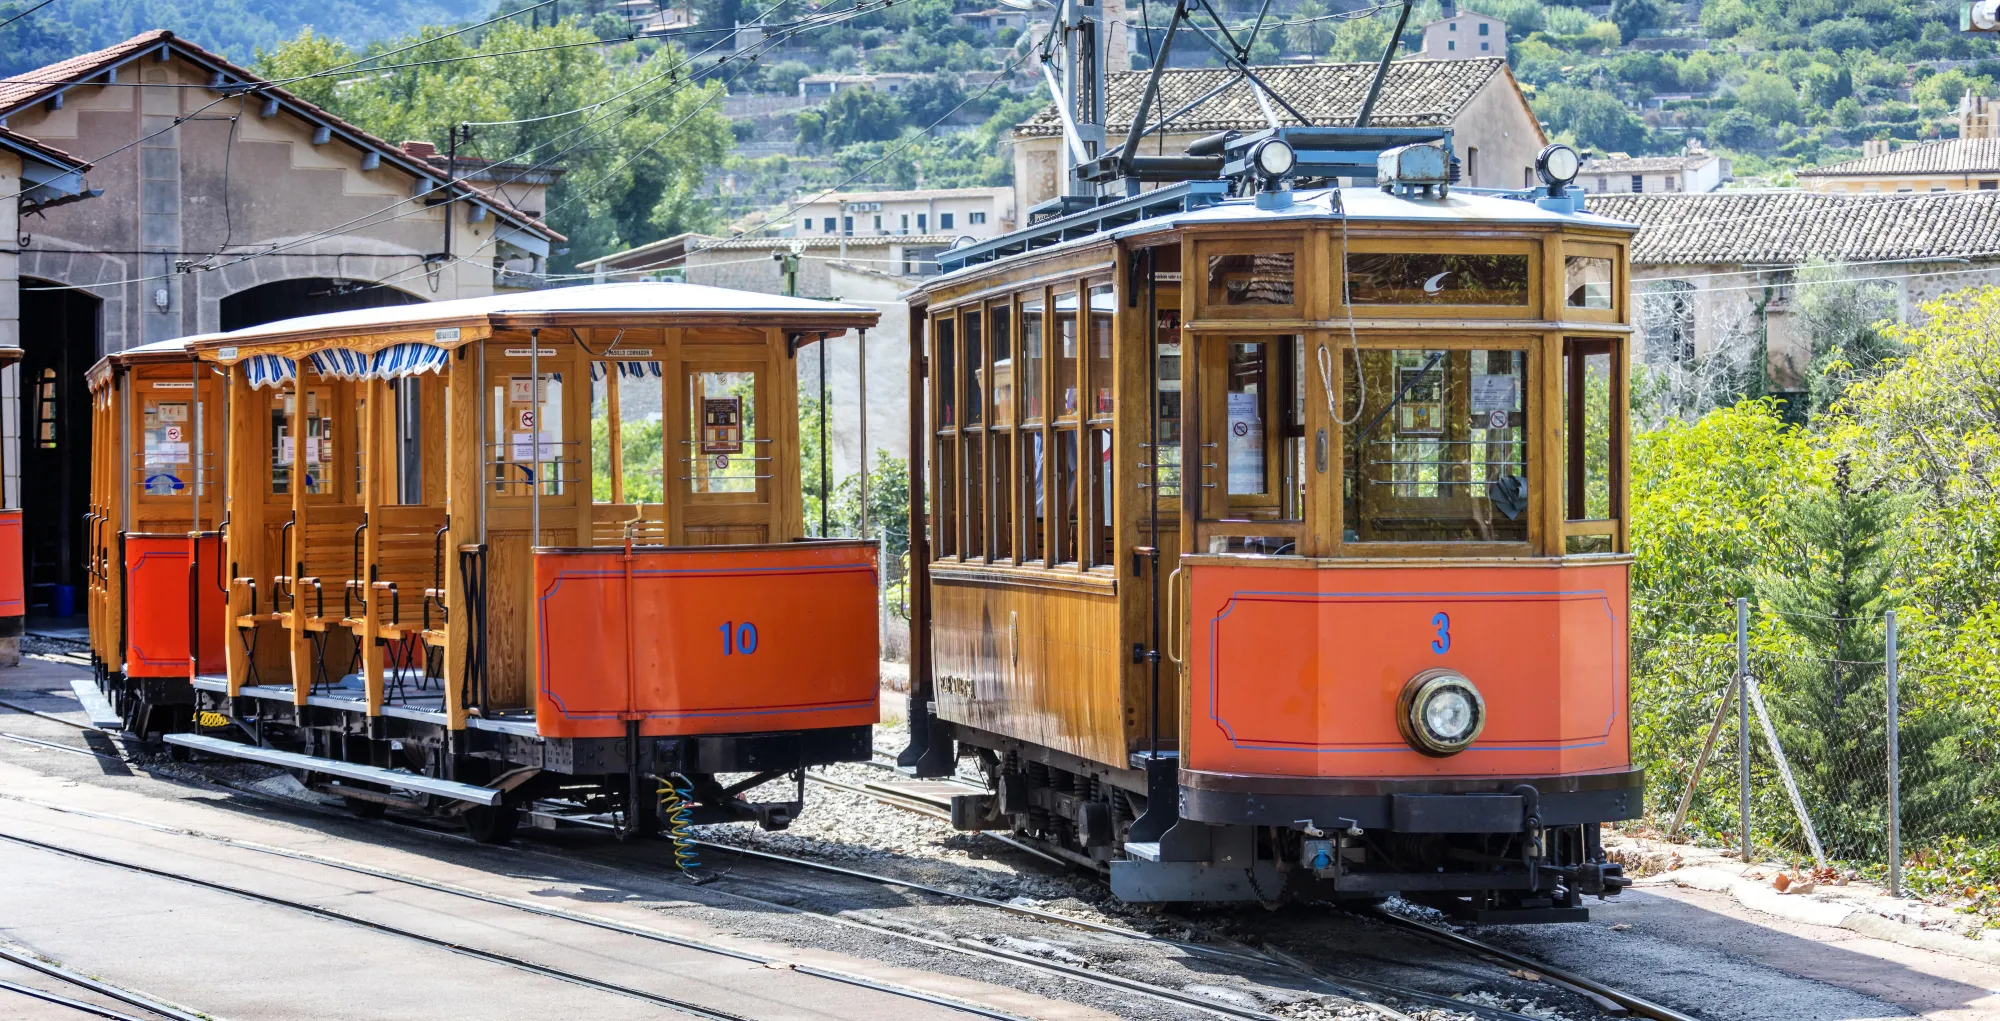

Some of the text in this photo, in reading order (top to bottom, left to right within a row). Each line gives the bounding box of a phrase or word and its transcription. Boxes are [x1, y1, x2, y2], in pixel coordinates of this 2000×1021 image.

[516, 383, 522, 392] 7
[719, 621, 758, 656] 10
[1432, 611, 1450, 655] 3
